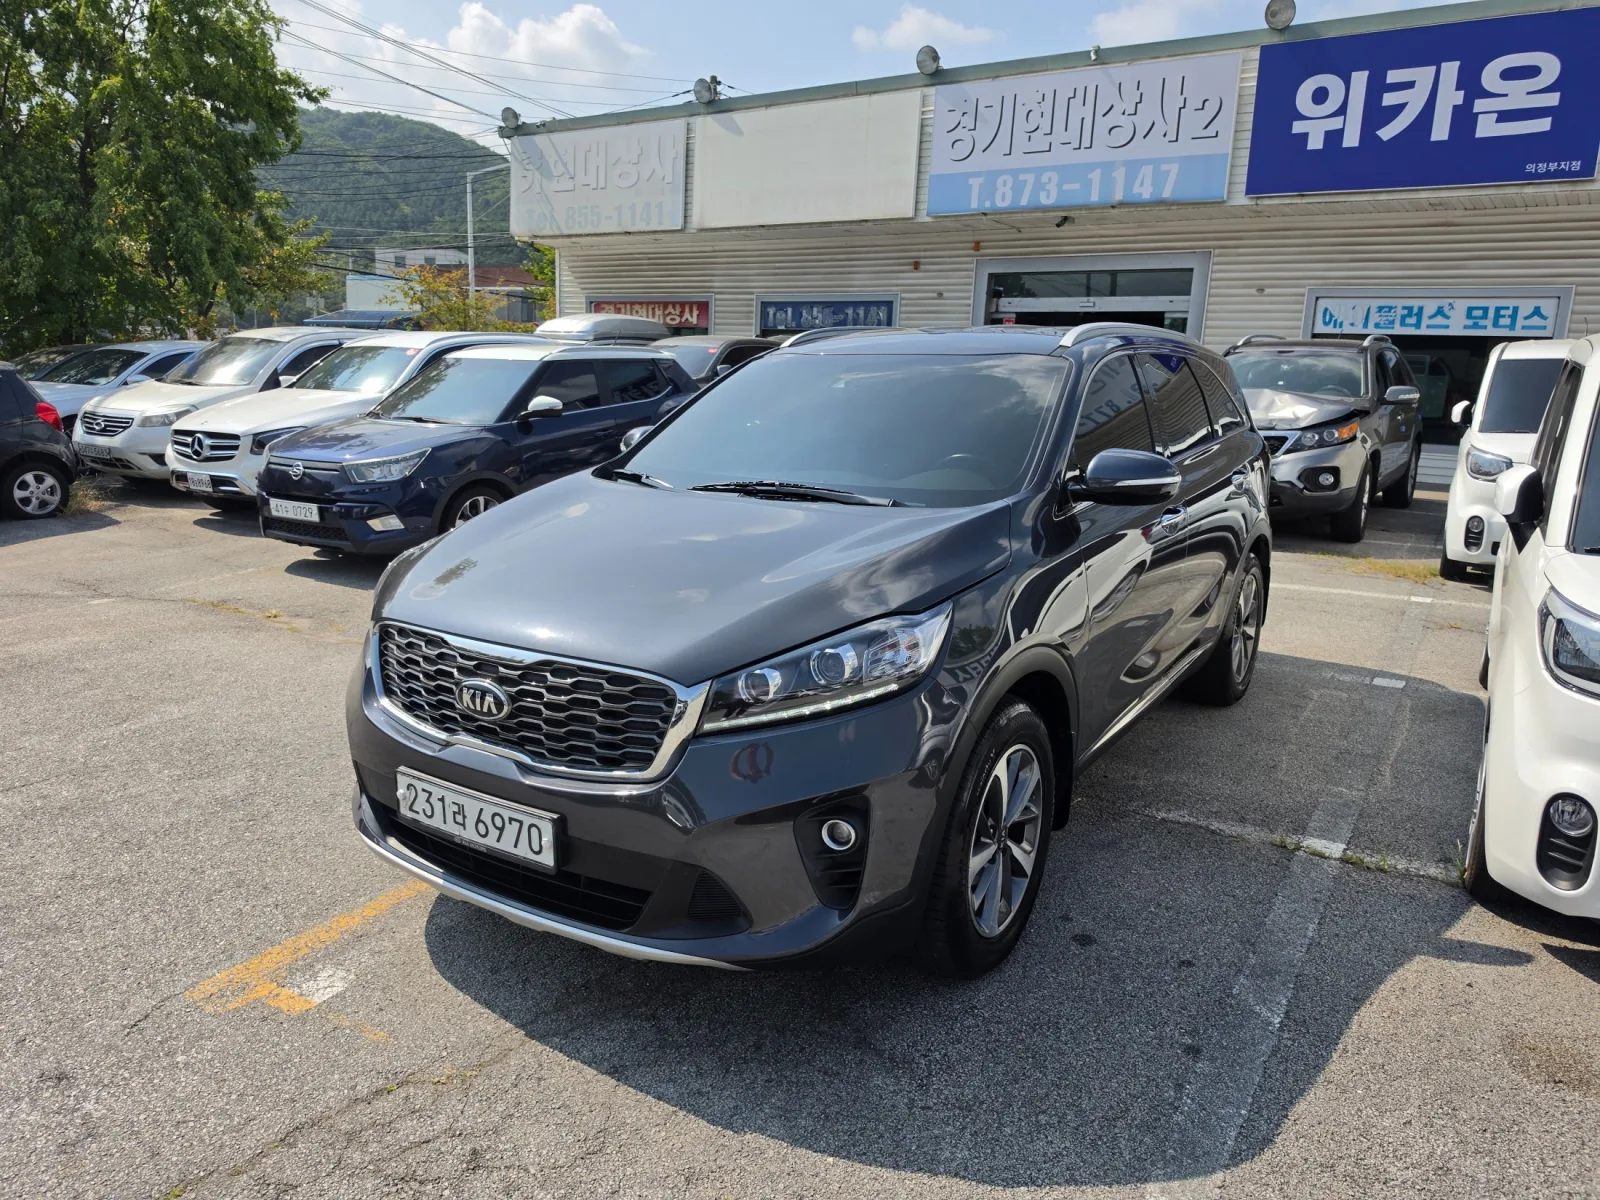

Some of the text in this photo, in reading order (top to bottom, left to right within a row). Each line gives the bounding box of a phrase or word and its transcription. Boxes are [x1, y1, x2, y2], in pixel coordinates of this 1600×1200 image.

[1292, 51, 1561, 150] 위카온
[1525, 160, 1581, 173] 의정부지점
[968, 163, 1179, 209] T.873-1147
[565, 200, 664, 230] 855-1141
[1463, 305, 1550, 332] 모터스
[293, 506, 313, 518] 0729
[462, 687, 498, 714] KIA
[407, 783, 543, 856] 231라 6970
